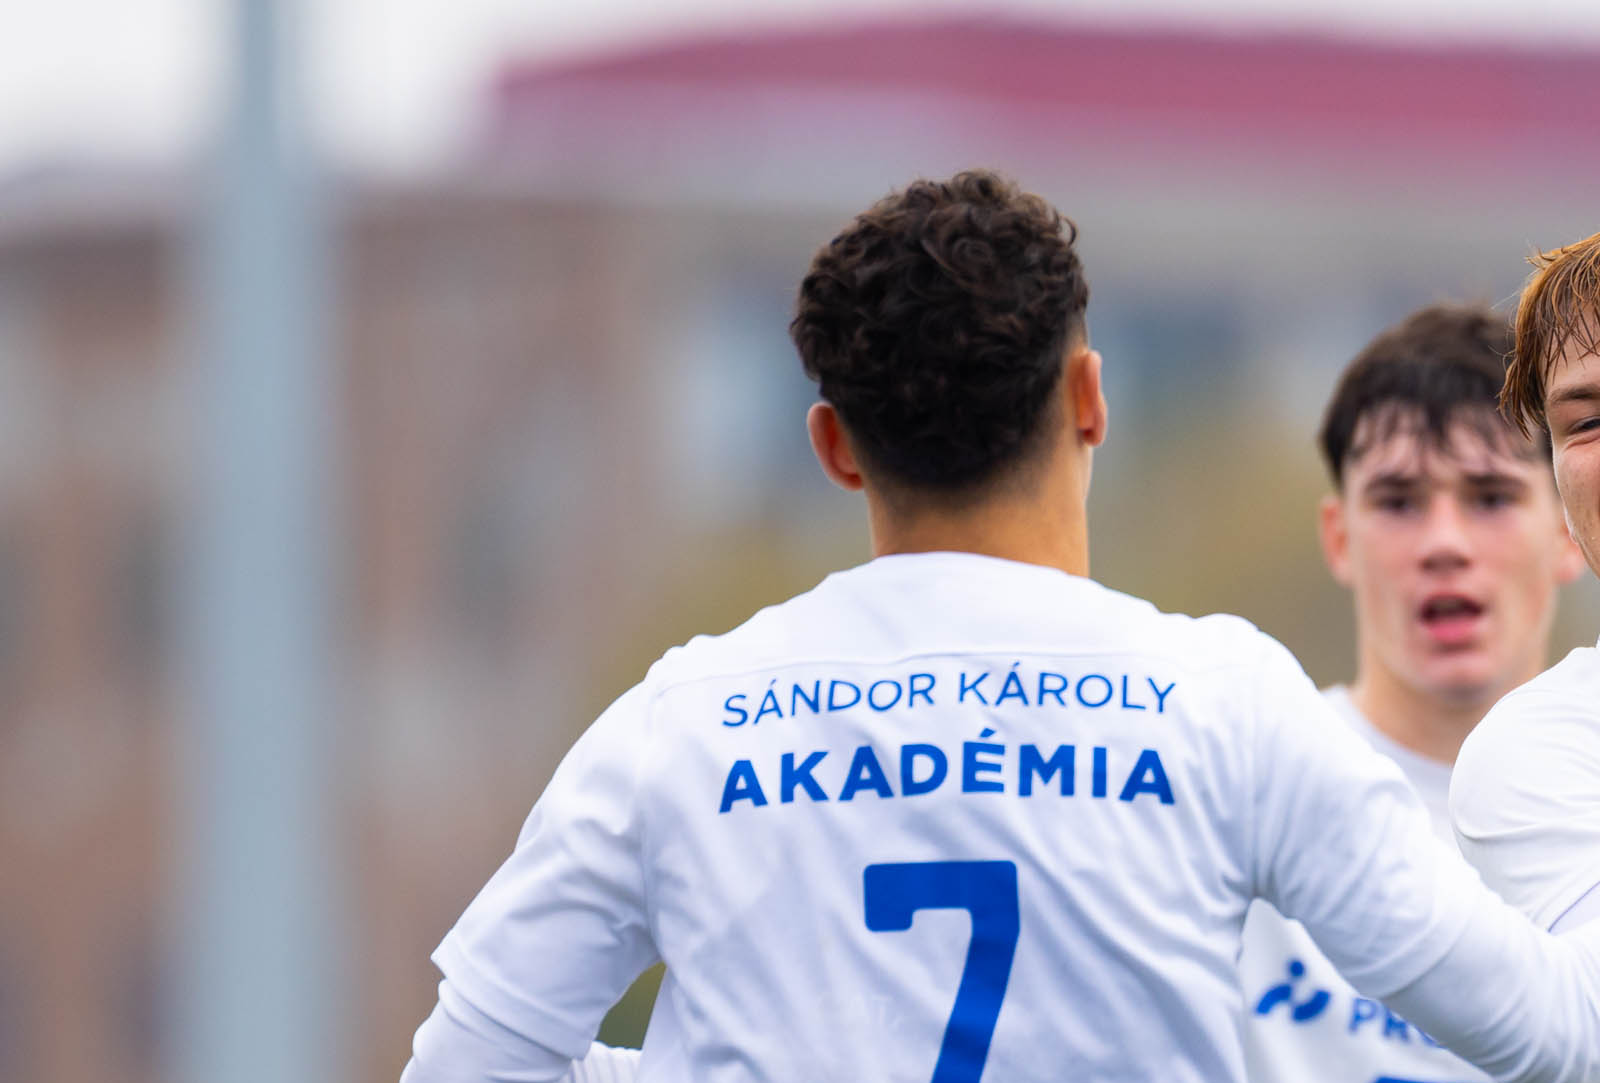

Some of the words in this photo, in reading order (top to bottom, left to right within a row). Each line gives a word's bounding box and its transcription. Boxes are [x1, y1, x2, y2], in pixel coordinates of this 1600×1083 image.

[722, 672, 937, 727] SÁNDOR
[958, 662, 1176, 714] KÁROLY
[719, 727, 1176, 814] AKADÉMIA
